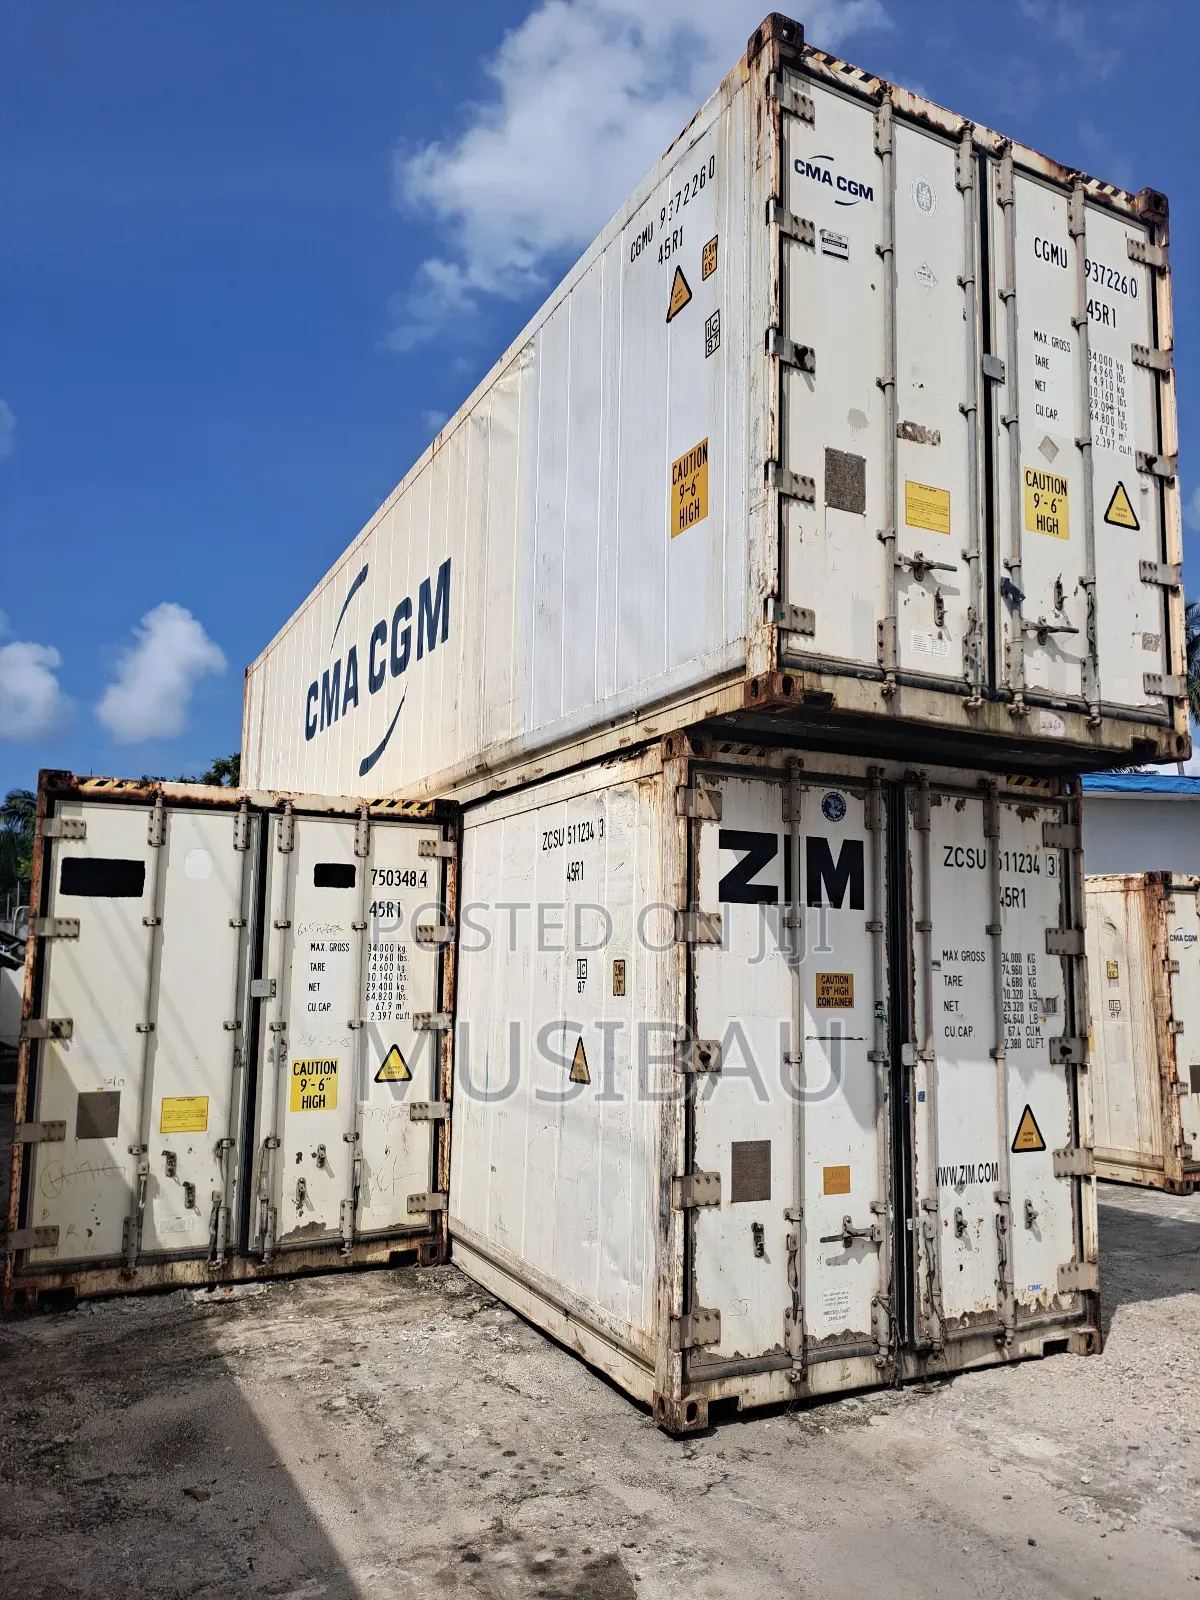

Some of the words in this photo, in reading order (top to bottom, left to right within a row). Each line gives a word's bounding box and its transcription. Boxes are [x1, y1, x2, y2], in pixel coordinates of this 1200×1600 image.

[794, 159, 833, 187] CMA
[836, 176, 874, 202] CGM
[630, 221, 654, 263] CGMU
[660, 154, 715, 230] 9372260
[658, 225, 683, 265] 45R1
[1034, 237, 1068, 269] CGMU
[1084, 259, 1138, 298] 9372260
[1086, 299, 1116, 328] 45R1
[1052, 337, 1071, 353] GROSS
[1034, 354, 1050, 370] TARE
[1116, 359, 1124, 374] kg
[1117, 371, 1126, 384] lbs
[1034, 379, 1047, 392] NET
[1117, 383, 1125, 397] kg
[1117, 394, 1127, 407] lbs
[1117, 407, 1126, 421] kg
[672, 441, 708, 486] CAUTION
[1025, 470, 1068, 496] CAUTION
[679, 497, 700, 530] HIGH
[1036, 513, 1060, 535] HIGH
[305, 644, 359, 742] CMA
[368, 556, 452, 695] CGM
[542, 828, 565, 851] ZCSU
[567, 821, 594, 845] 511234
[943, 845, 987, 869] ZCSU
[567, 860, 584, 882] 45R1
[719, 829, 865, 910] ZIM
[371, 868, 428, 887] 7503484
[369, 900, 401, 918] 45R1
[1169, 934, 1183, 942] CMA
[1183, 934, 1198, 942] CGM
[329, 943, 350, 952] GROSS
[367, 943, 394, 952] 34.000
[367, 953, 394, 962] 74.960
[942, 949, 959, 961] MAX
[961, 950, 986, 962] GROSS
[1001, 952, 1023, 963] 34.000
[1027, 953, 1036, 964] KG
[310, 962, 326, 972] TARE
[371, 962, 394, 972] 4.600
[1027, 964, 1037, 976] LB
[820, 974, 849, 985] CAUTION
[943, 974, 964, 987] TARE
[1028, 976, 1037, 988] KG
[308, 982, 321, 992] NET
[366, 982, 393, 992] 29.400
[833, 986, 849, 996] HIGH
[365, 991, 393, 1001] 64.820
[1028, 988, 1038, 1000] LB
[375, 1001, 393, 1011] 67.9
[817, 996, 853, 1007] CONTAINER
[943, 1000, 960, 1012] NET
[1028, 1001, 1038, 1012] KG
[370, 1011, 392, 1021] 2.397
[1029, 1013, 1039, 1025] LB
[944, 1026, 976, 1038] CU.CAP.
[1008, 1025, 1021, 1037] 67.4
[293, 1060, 338, 1076] CAUTION
[301, 1094, 327, 1109] HIGH
